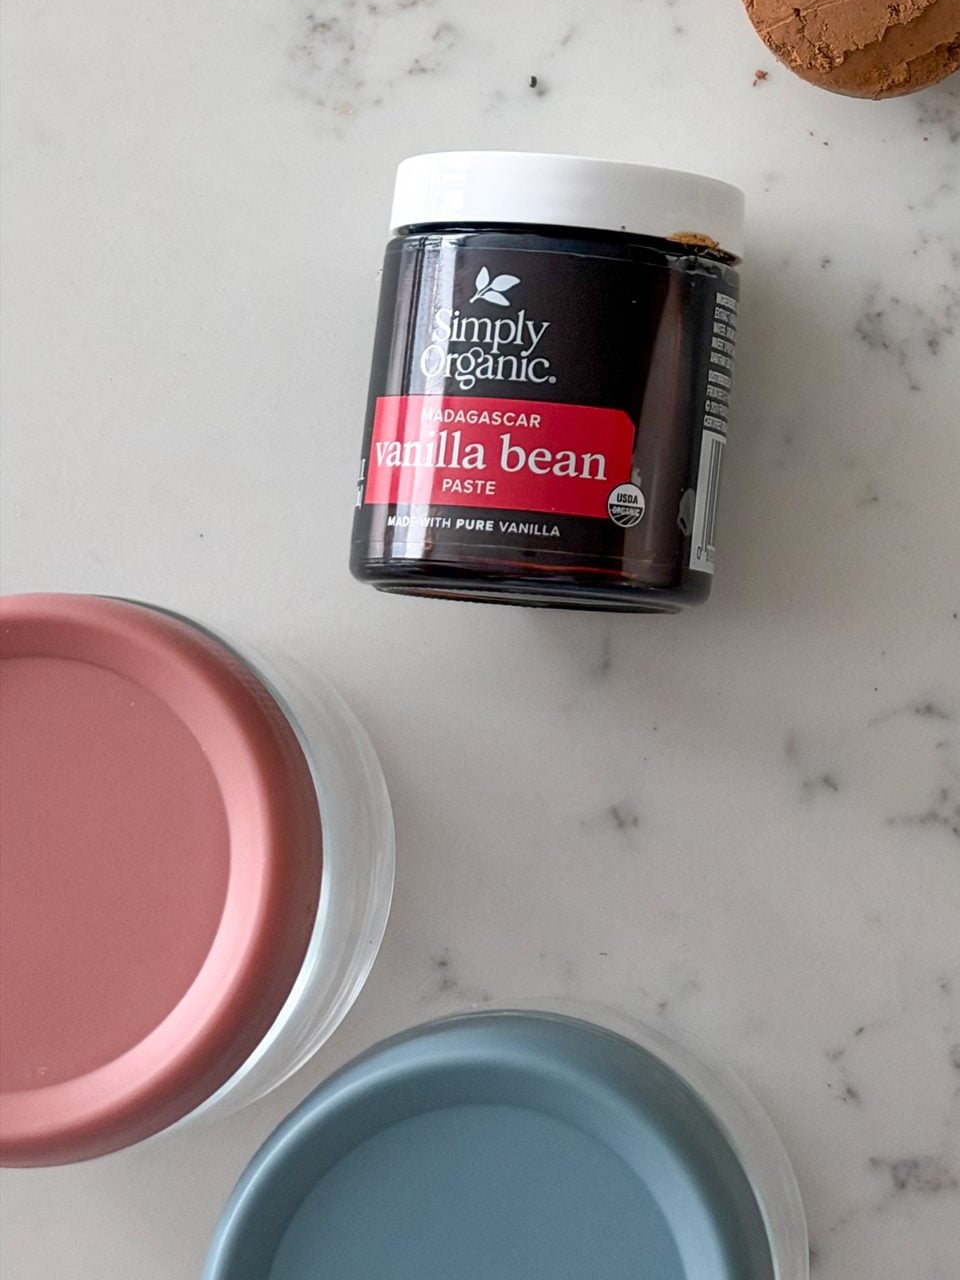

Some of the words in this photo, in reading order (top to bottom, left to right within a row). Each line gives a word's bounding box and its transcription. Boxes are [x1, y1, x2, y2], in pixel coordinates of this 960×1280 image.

[432, 308, 550, 357] Simply
[420, 344, 557, 390] Organic.
[422, 408, 541, 428] MADAGASCAR
[375, 429, 487, 470] vanilla
[500, 433, 607, 481] bean
[441, 478, 496, 495] PASTE
[616, 493, 638, 505] USDA
[387, 516, 416, 527] MADE
[420, 517, 451, 528] WITH
[456, 518, 494, 531] PURE
[500, 521, 560, 537] VANILLA
